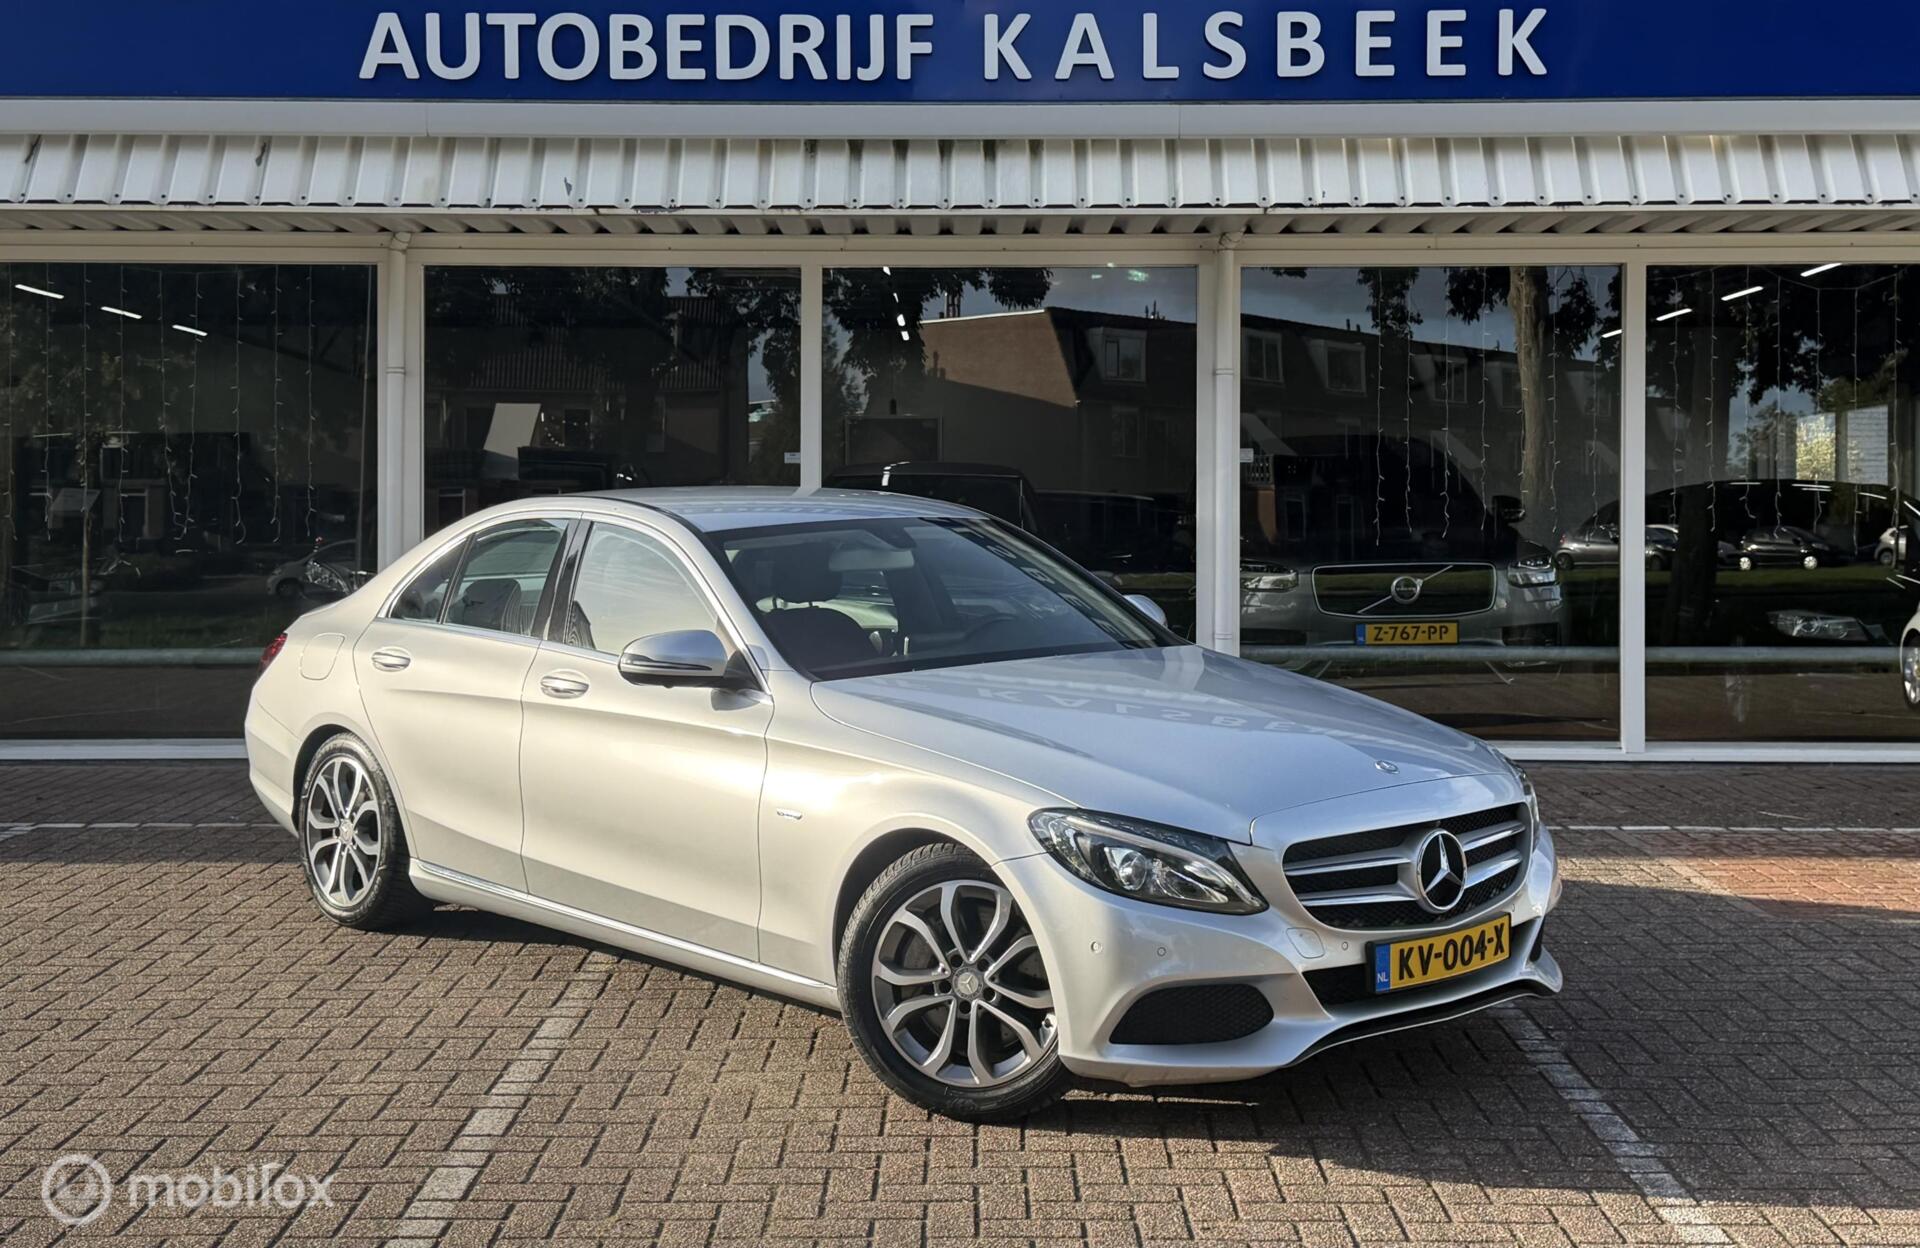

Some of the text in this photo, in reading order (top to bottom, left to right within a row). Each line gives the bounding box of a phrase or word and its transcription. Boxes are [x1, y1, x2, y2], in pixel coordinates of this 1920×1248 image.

[358, 8, 1547, 81] AUTOBEDRIJF KALSBEEK
[1373, 625, 1449, 642] Z-767-PP
[1398, 922, 1505, 980] KV-004-X
[1376, 972, 1389, 982] NL
